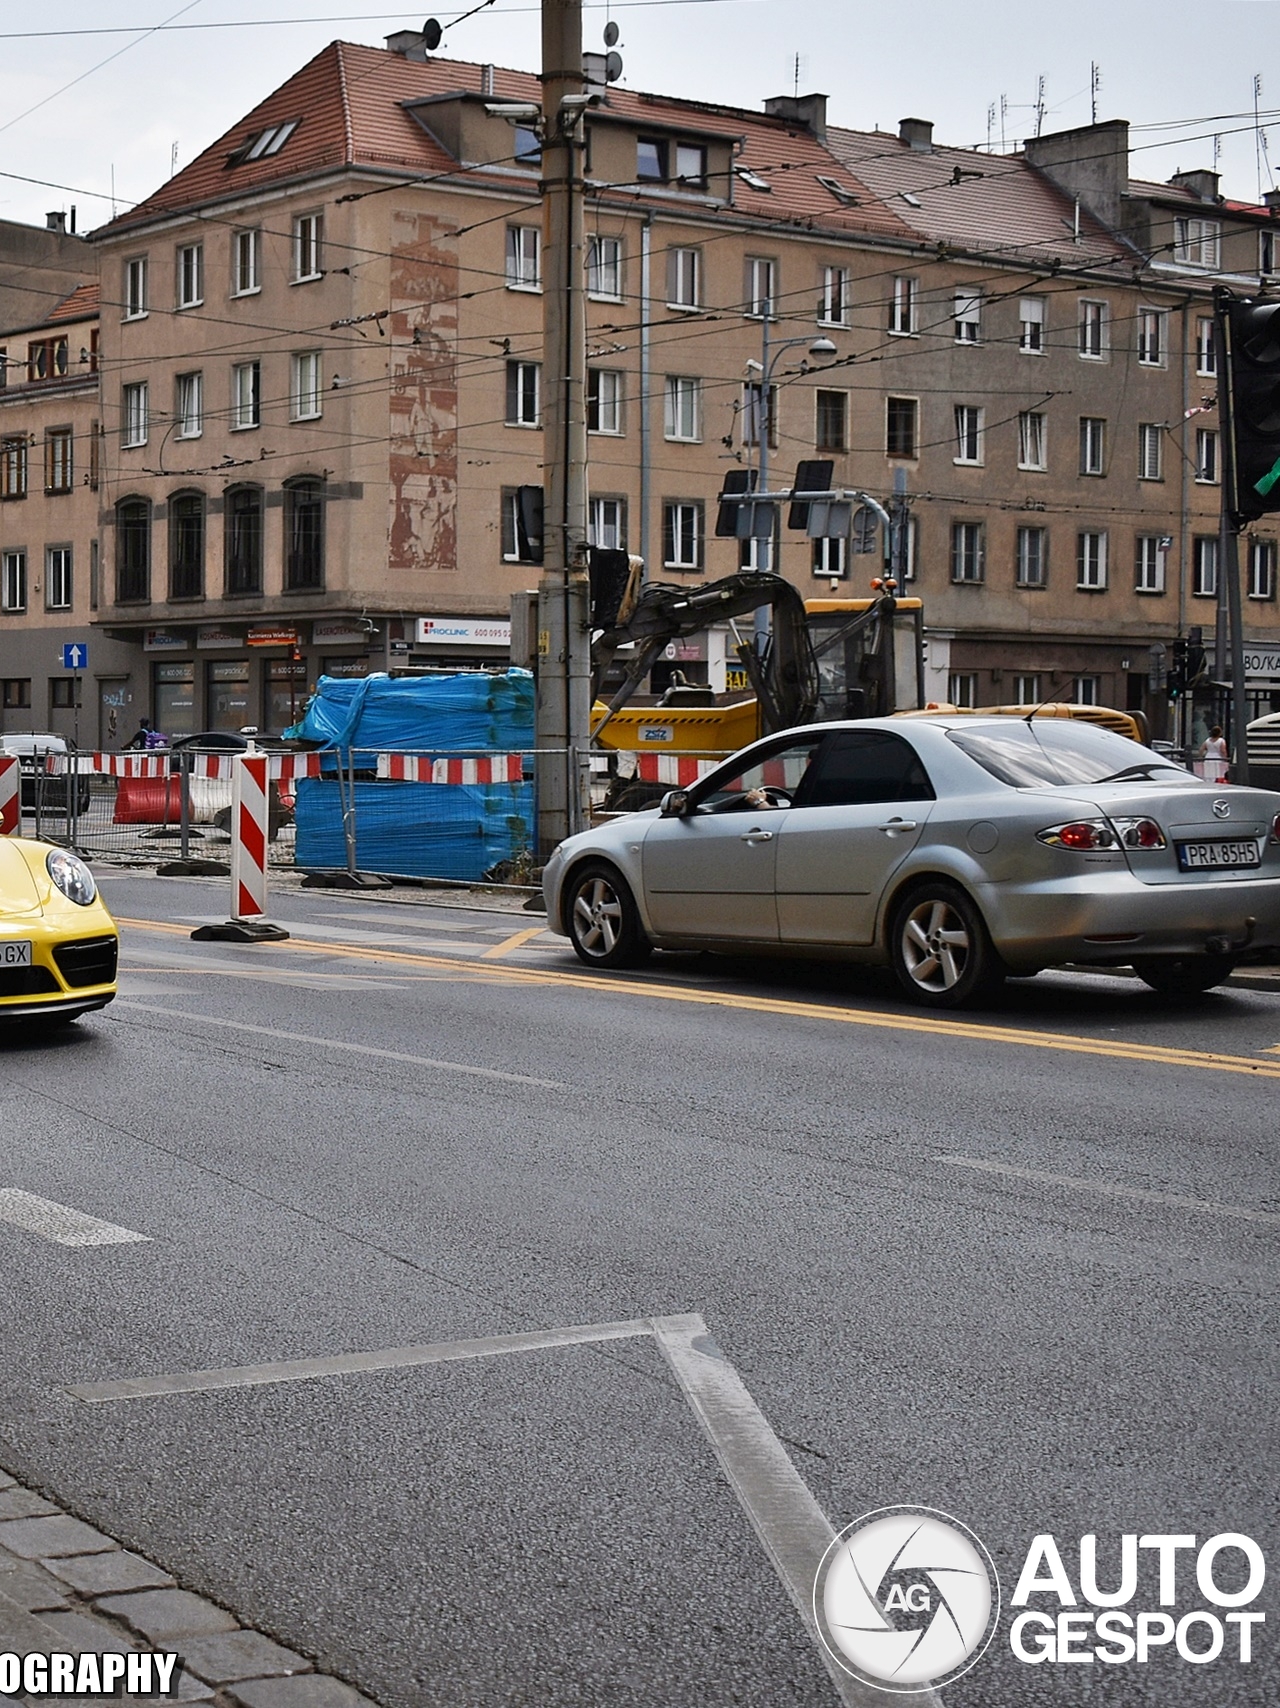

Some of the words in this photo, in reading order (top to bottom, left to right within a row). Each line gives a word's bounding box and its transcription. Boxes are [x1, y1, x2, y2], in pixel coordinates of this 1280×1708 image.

[429, 628, 469, 636] PROCLINIC
[475, 628, 487, 637] 600
[489, 629, 502, 637] 095
[1188, 845, 1218, 864] PRA
[1221, 843, 1256, 863] 85H5
